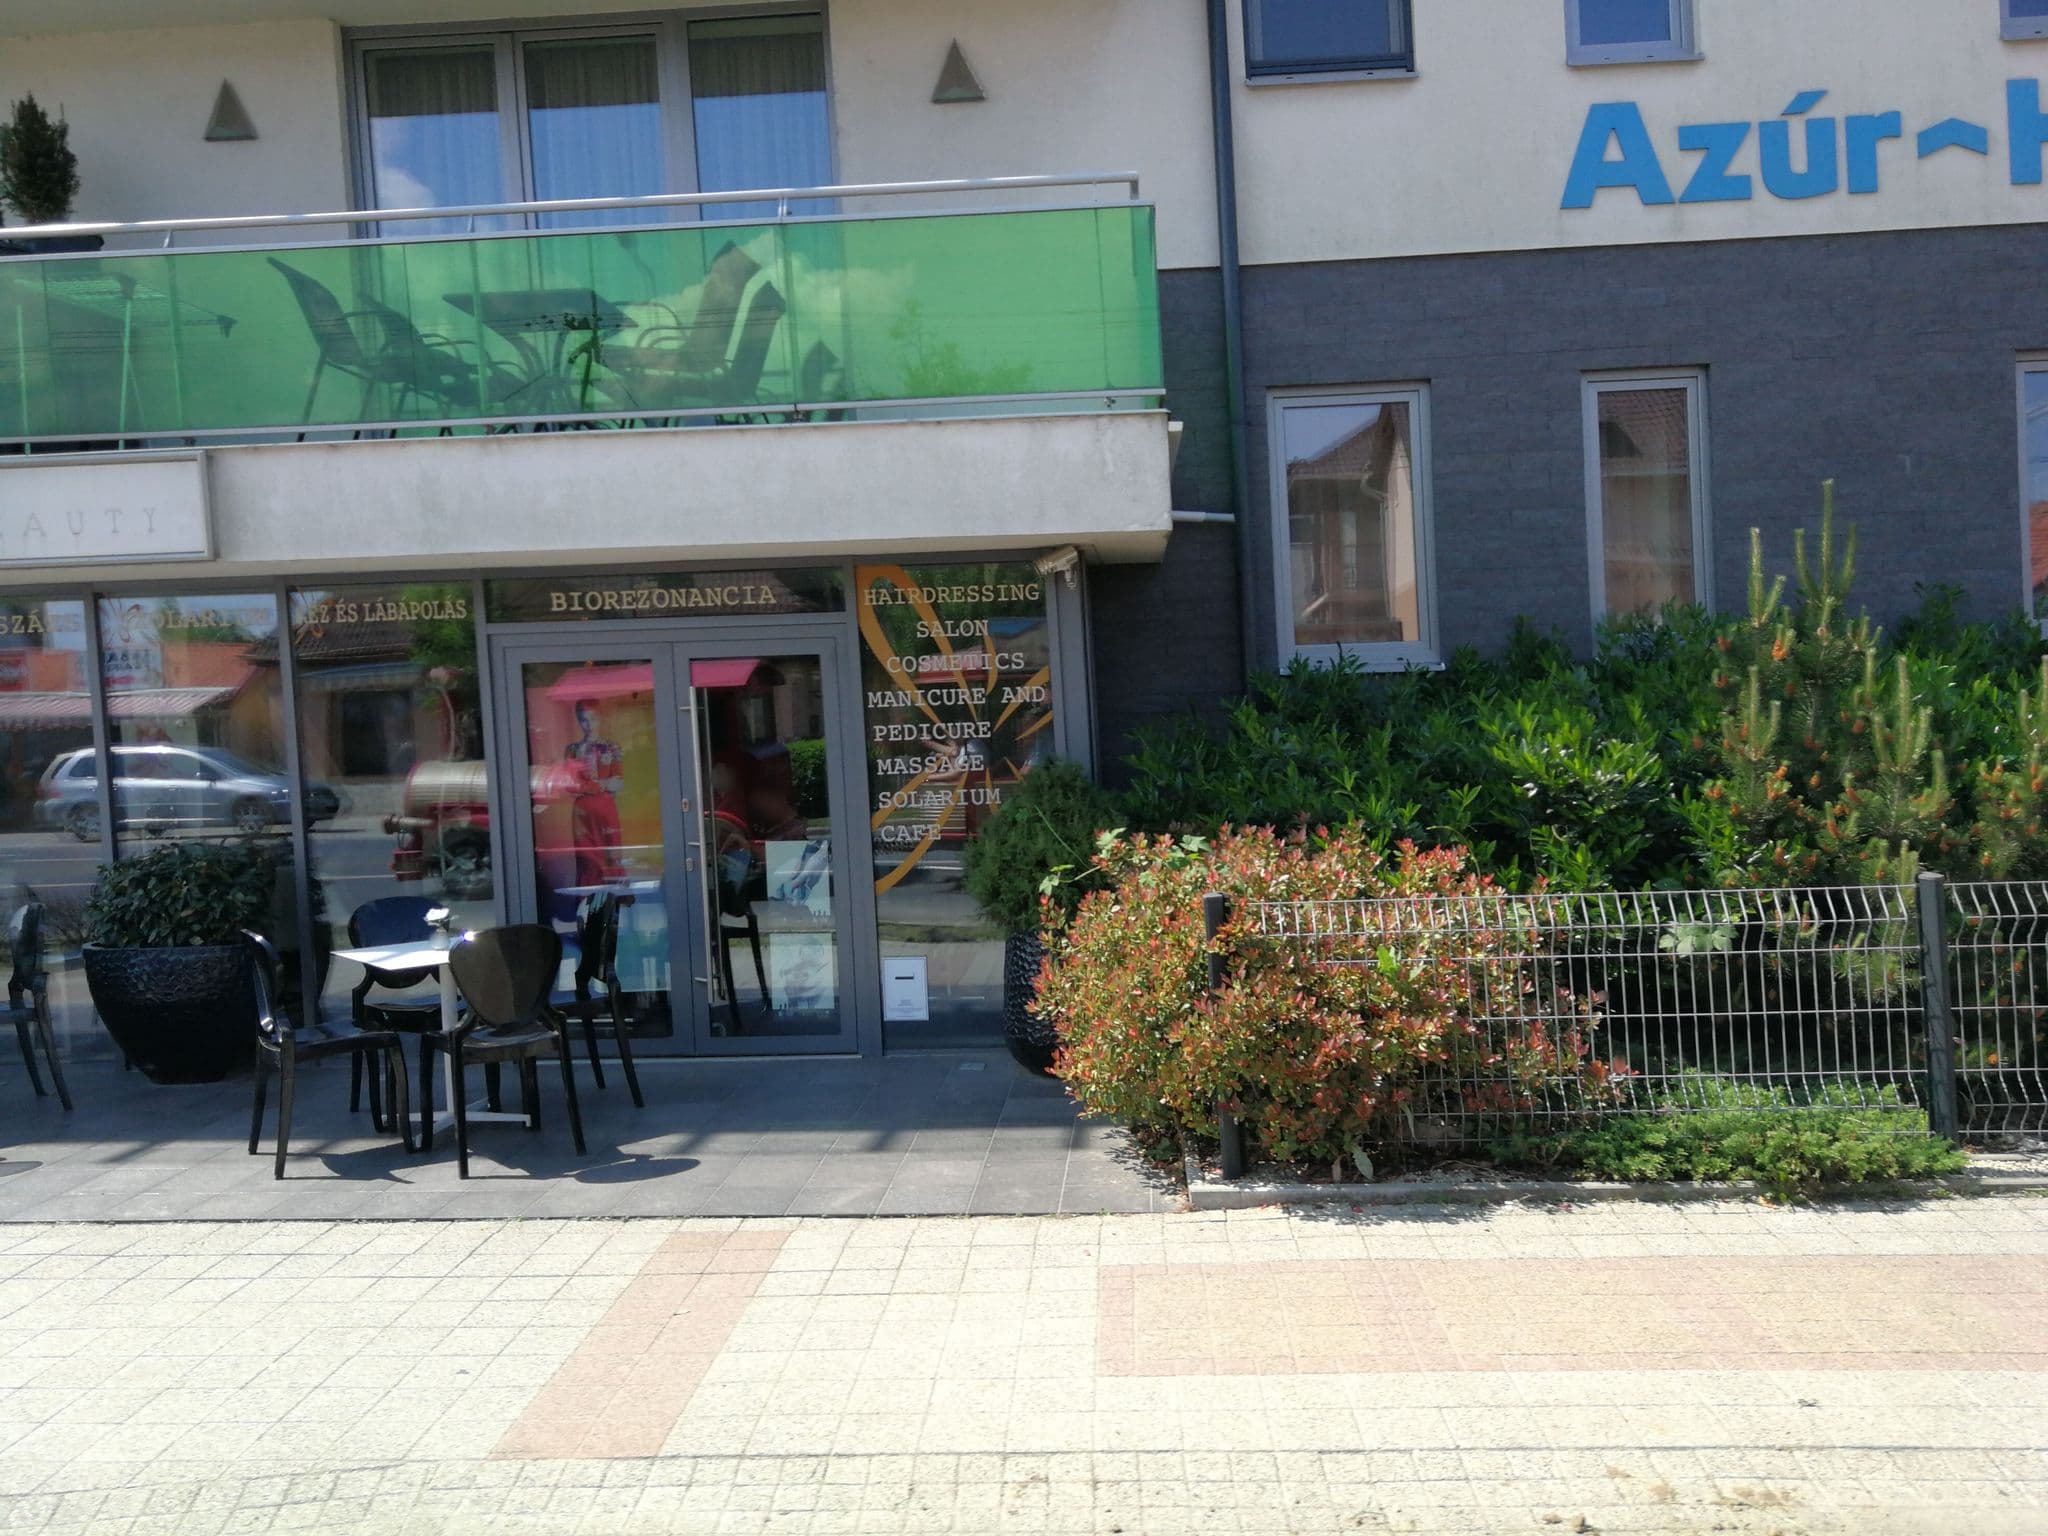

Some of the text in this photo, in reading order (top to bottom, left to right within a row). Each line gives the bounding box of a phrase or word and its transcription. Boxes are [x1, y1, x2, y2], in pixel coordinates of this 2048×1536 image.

[1560, 90, 1901, 209] Azúr
[0, 506, 157, 538] AUTY
[550, 586, 775, 612] BIOREZONANCIA
[864, 584, 1040, 606] HAIRDRESSING
[335, 597, 358, 623] ÉS
[363, 595, 468, 622] LÁBÁPOLÁS
[916, 620, 988, 637] SALON
[887, 653, 1025, 673] COSMETICS
[868, 686, 1046, 708] MANICURE AND
[873, 722, 992, 742] PEDICURE
[877, 755, 985, 775] MASSAGE
[878, 788, 1002, 809] SOLARIUM
[881, 824, 942, 841] CAFE
